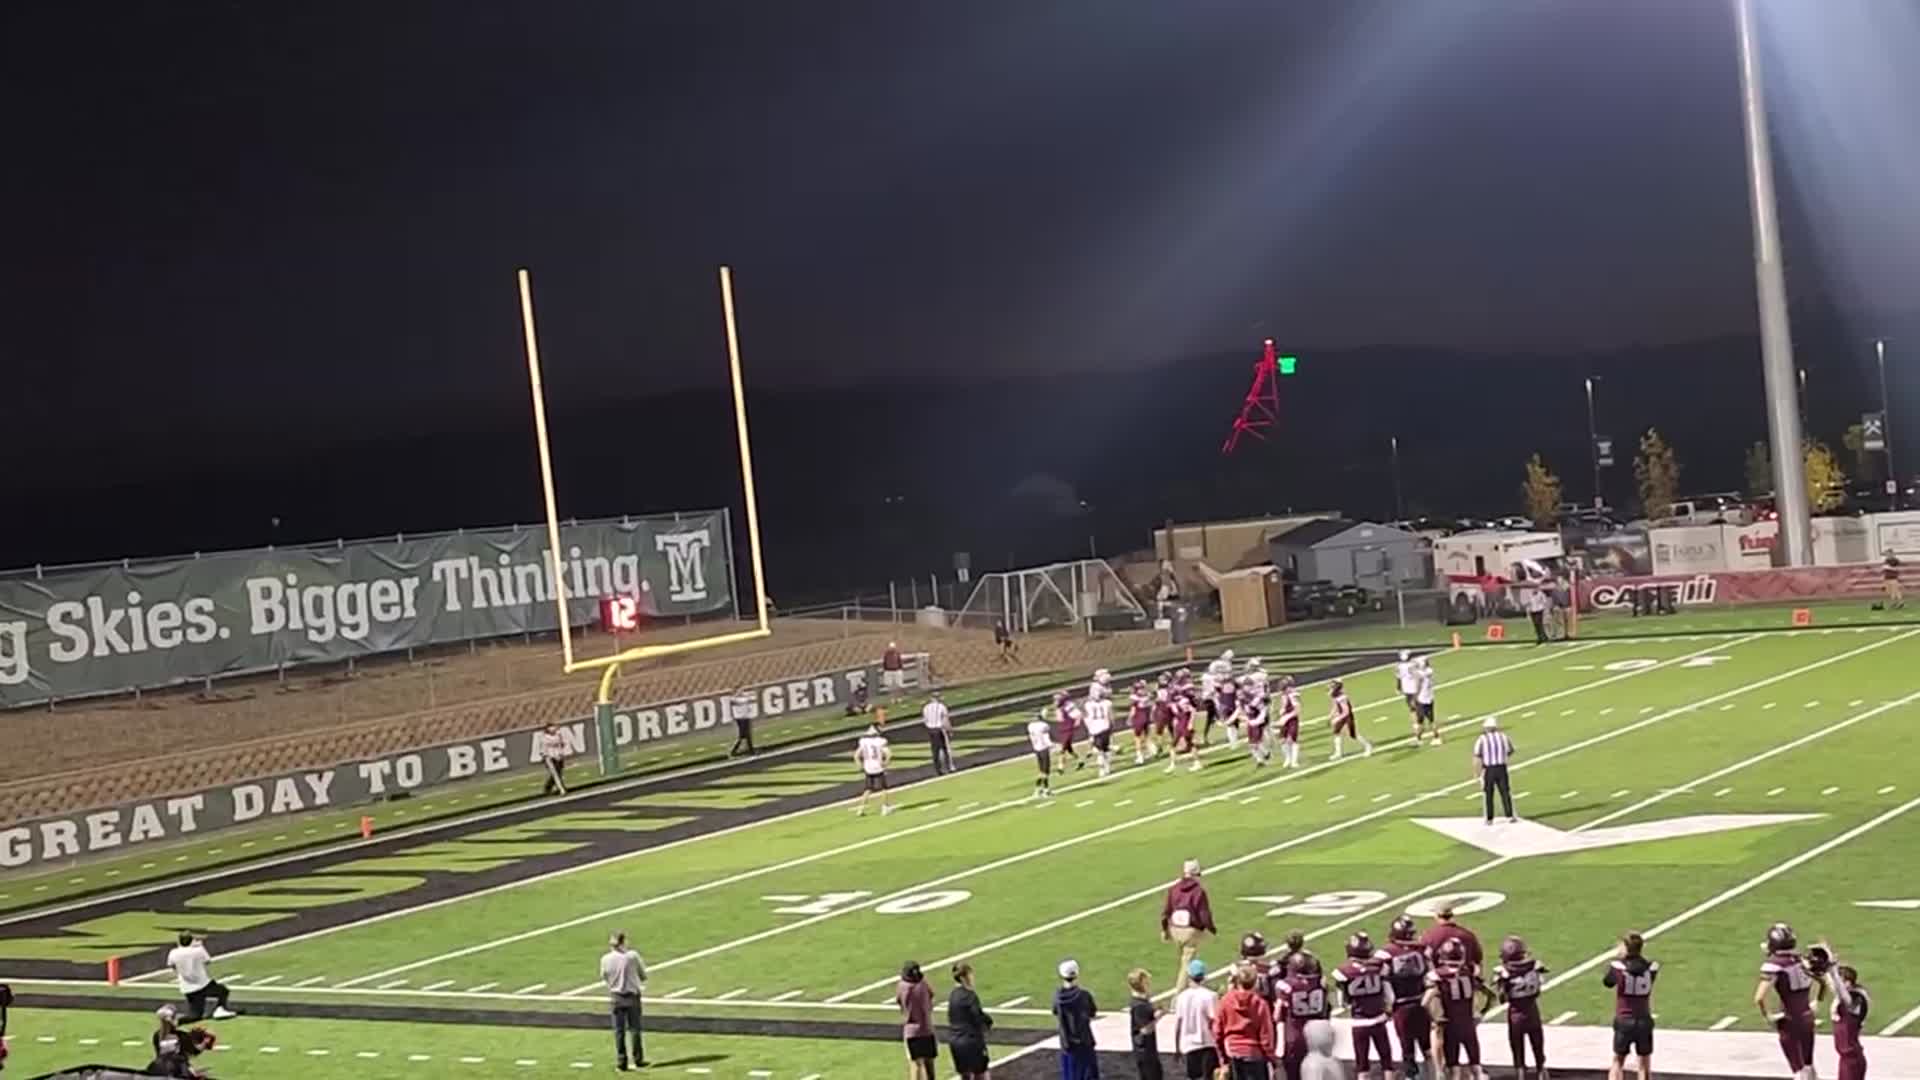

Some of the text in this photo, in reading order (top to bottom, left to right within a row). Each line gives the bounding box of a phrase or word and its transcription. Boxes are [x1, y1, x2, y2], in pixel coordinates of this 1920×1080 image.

[47, 590, 231, 663] Skies.
[246, 573, 419, 643] Bigger
[432, 546, 650, 612] Thinking.
[609, 598, 636, 628] 12
[0, 794, 205, 867] GREAT
[232, 770, 335, 822] DAY
[359, 754, 423, 795] TO
[447, 738, 510, 779] BE
[1449, 974, 1474, 1001] 11
